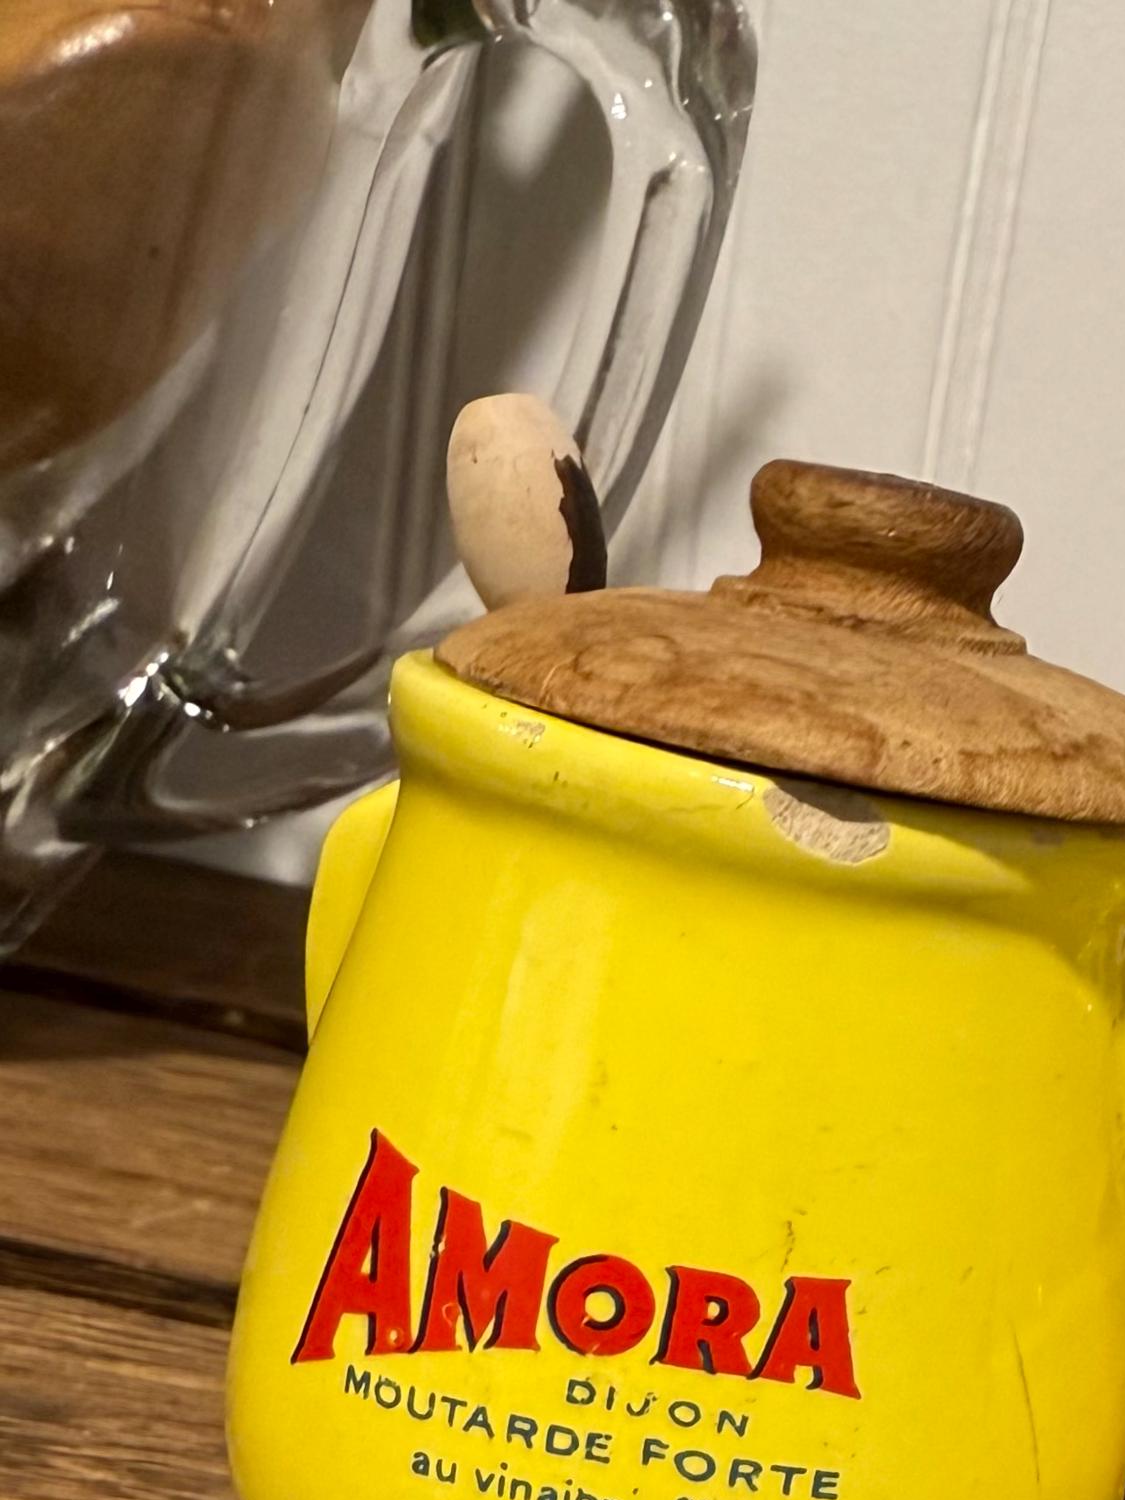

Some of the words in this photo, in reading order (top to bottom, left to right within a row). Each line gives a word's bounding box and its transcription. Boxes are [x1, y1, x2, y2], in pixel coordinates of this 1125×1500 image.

[290, 1128, 861, 1399] AMORA
[344, 1364, 612, 1464] MOUTARDE
[642, 1438, 841, 1500] FORTE
[566, 1378, 751, 1438] DIJON
[411, 1448, 457, 1485] au
